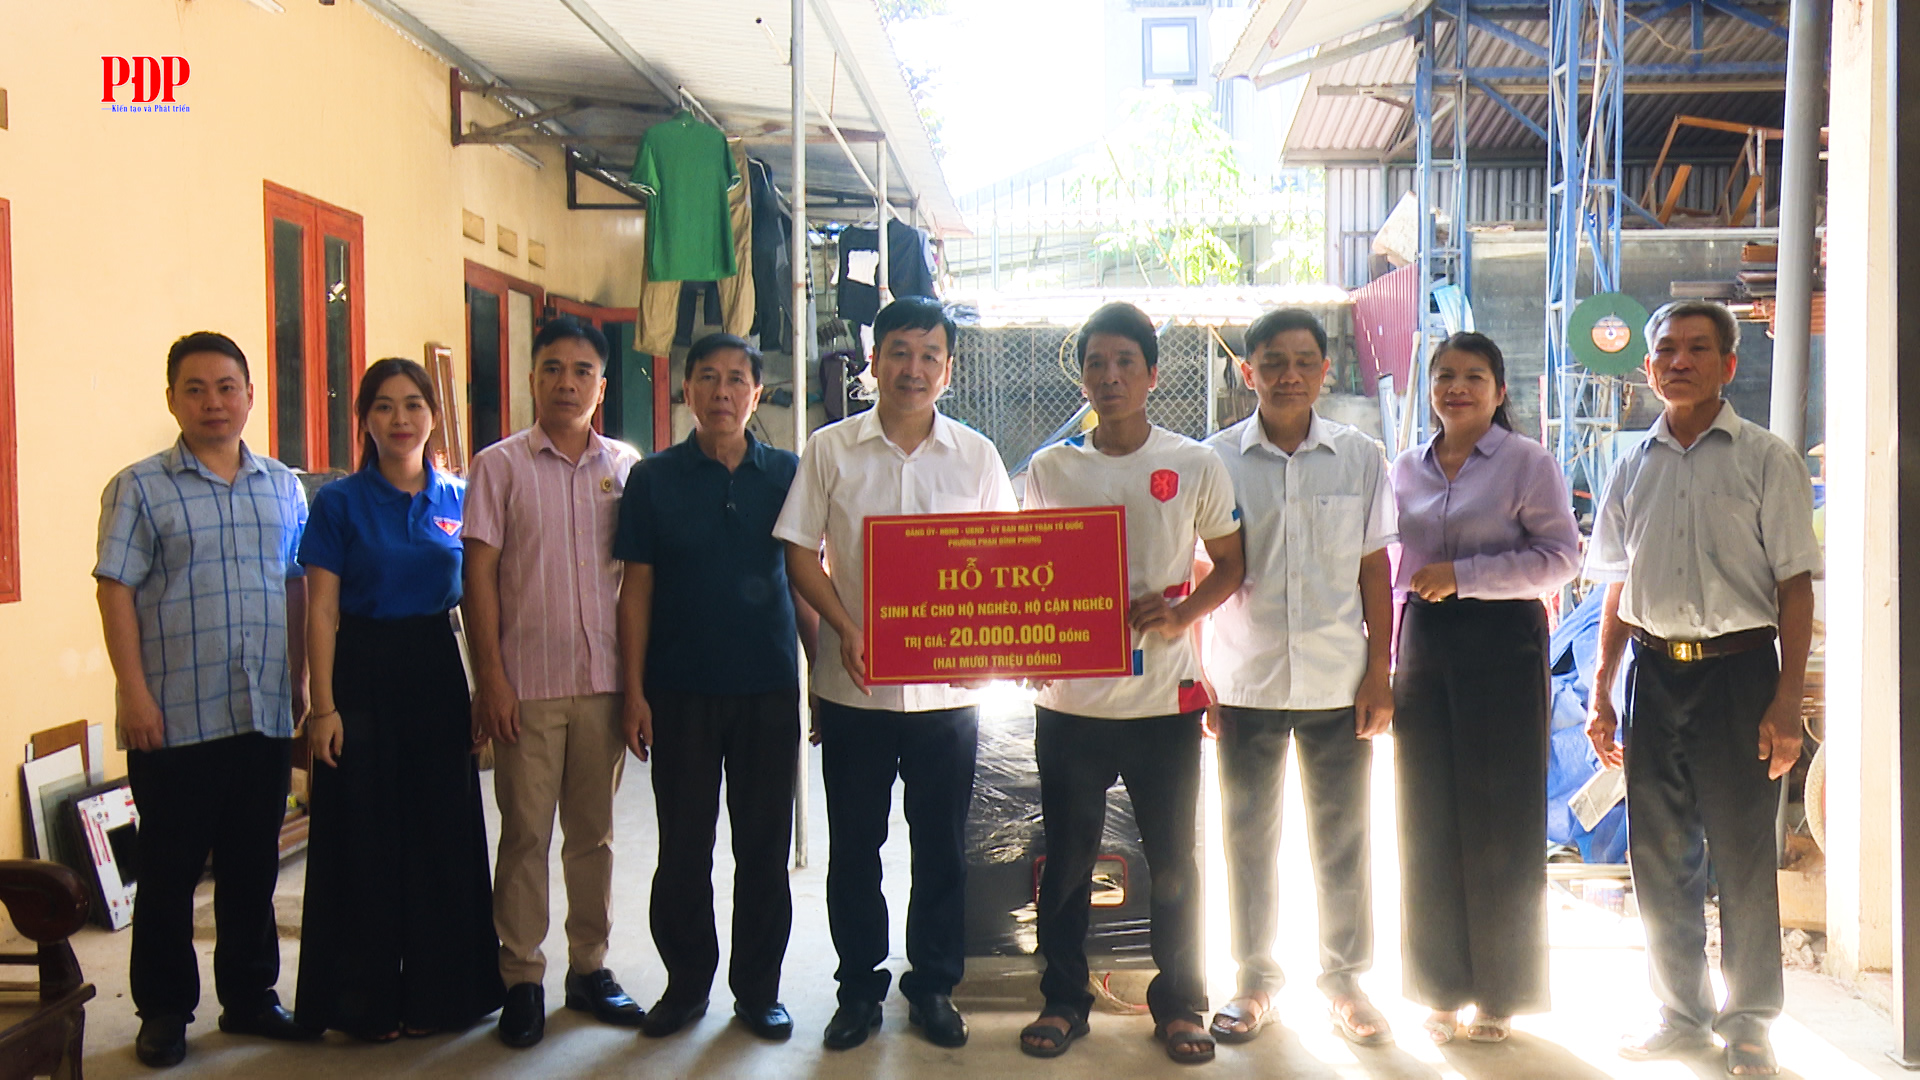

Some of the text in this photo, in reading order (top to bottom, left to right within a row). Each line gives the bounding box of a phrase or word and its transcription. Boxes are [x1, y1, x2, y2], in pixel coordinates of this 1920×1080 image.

[937, 557, 1055, 592] HỖ TRỢ
[880, 605, 909, 619] SINH
[912, 601, 928, 618] KẾ
[930, 603, 955, 617] CHO
[958, 601, 975, 619] HỘ
[1025, 598, 1041, 616] HỘ
[1044, 597, 1070, 616] CẬN
[1073, 595, 1114, 611] NGHÈO
[904, 623, 1090, 651] TRỊ GIÁ: 20.000.000 ĐỒNG
[933, 656, 956, 671] (HAI
[959, 655, 989, 668] MƯƠI
[991, 652, 1023, 669] TRIỆU
